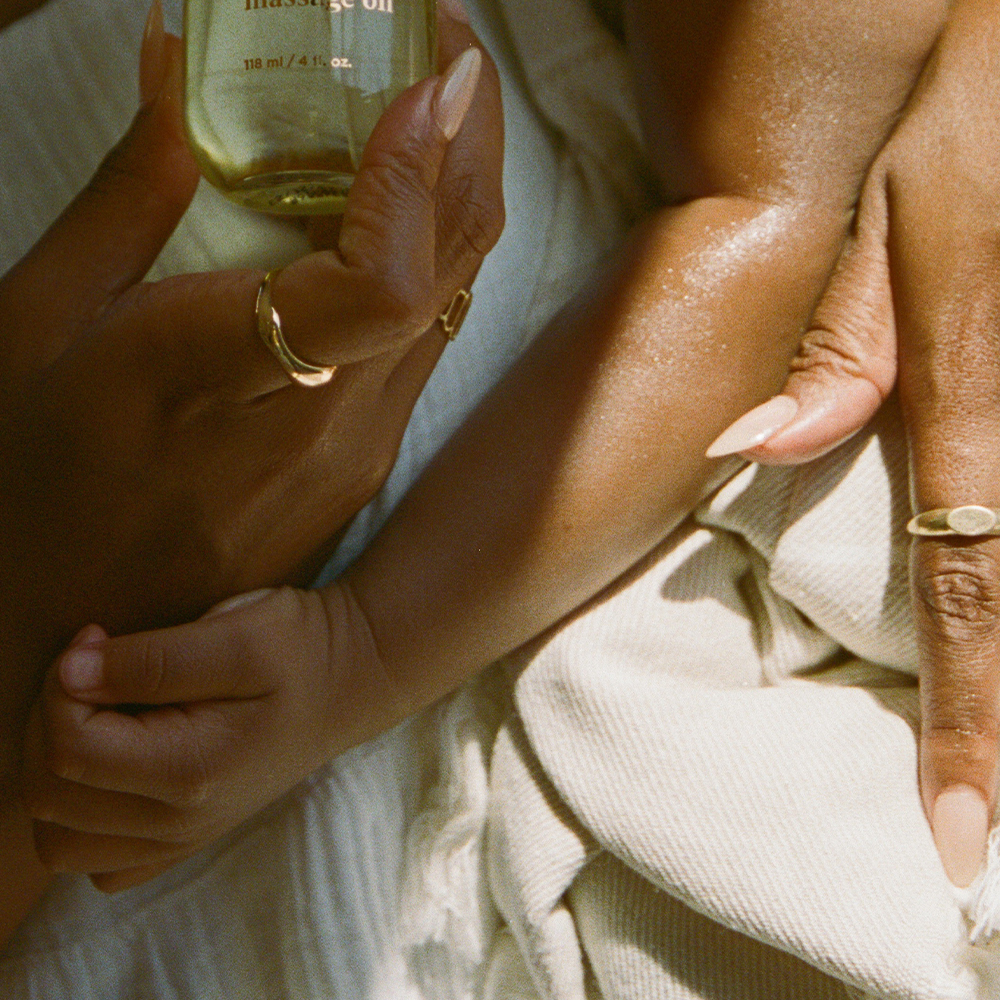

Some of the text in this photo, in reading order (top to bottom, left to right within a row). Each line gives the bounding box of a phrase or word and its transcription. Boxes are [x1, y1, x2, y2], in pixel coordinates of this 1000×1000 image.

[243, 58, 262, 70] 118
[267, 56, 283, 68] ml
[287, 54, 295, 68] /
[298, 55, 308, 66] 4
[331, 57, 353, 68] oz.
